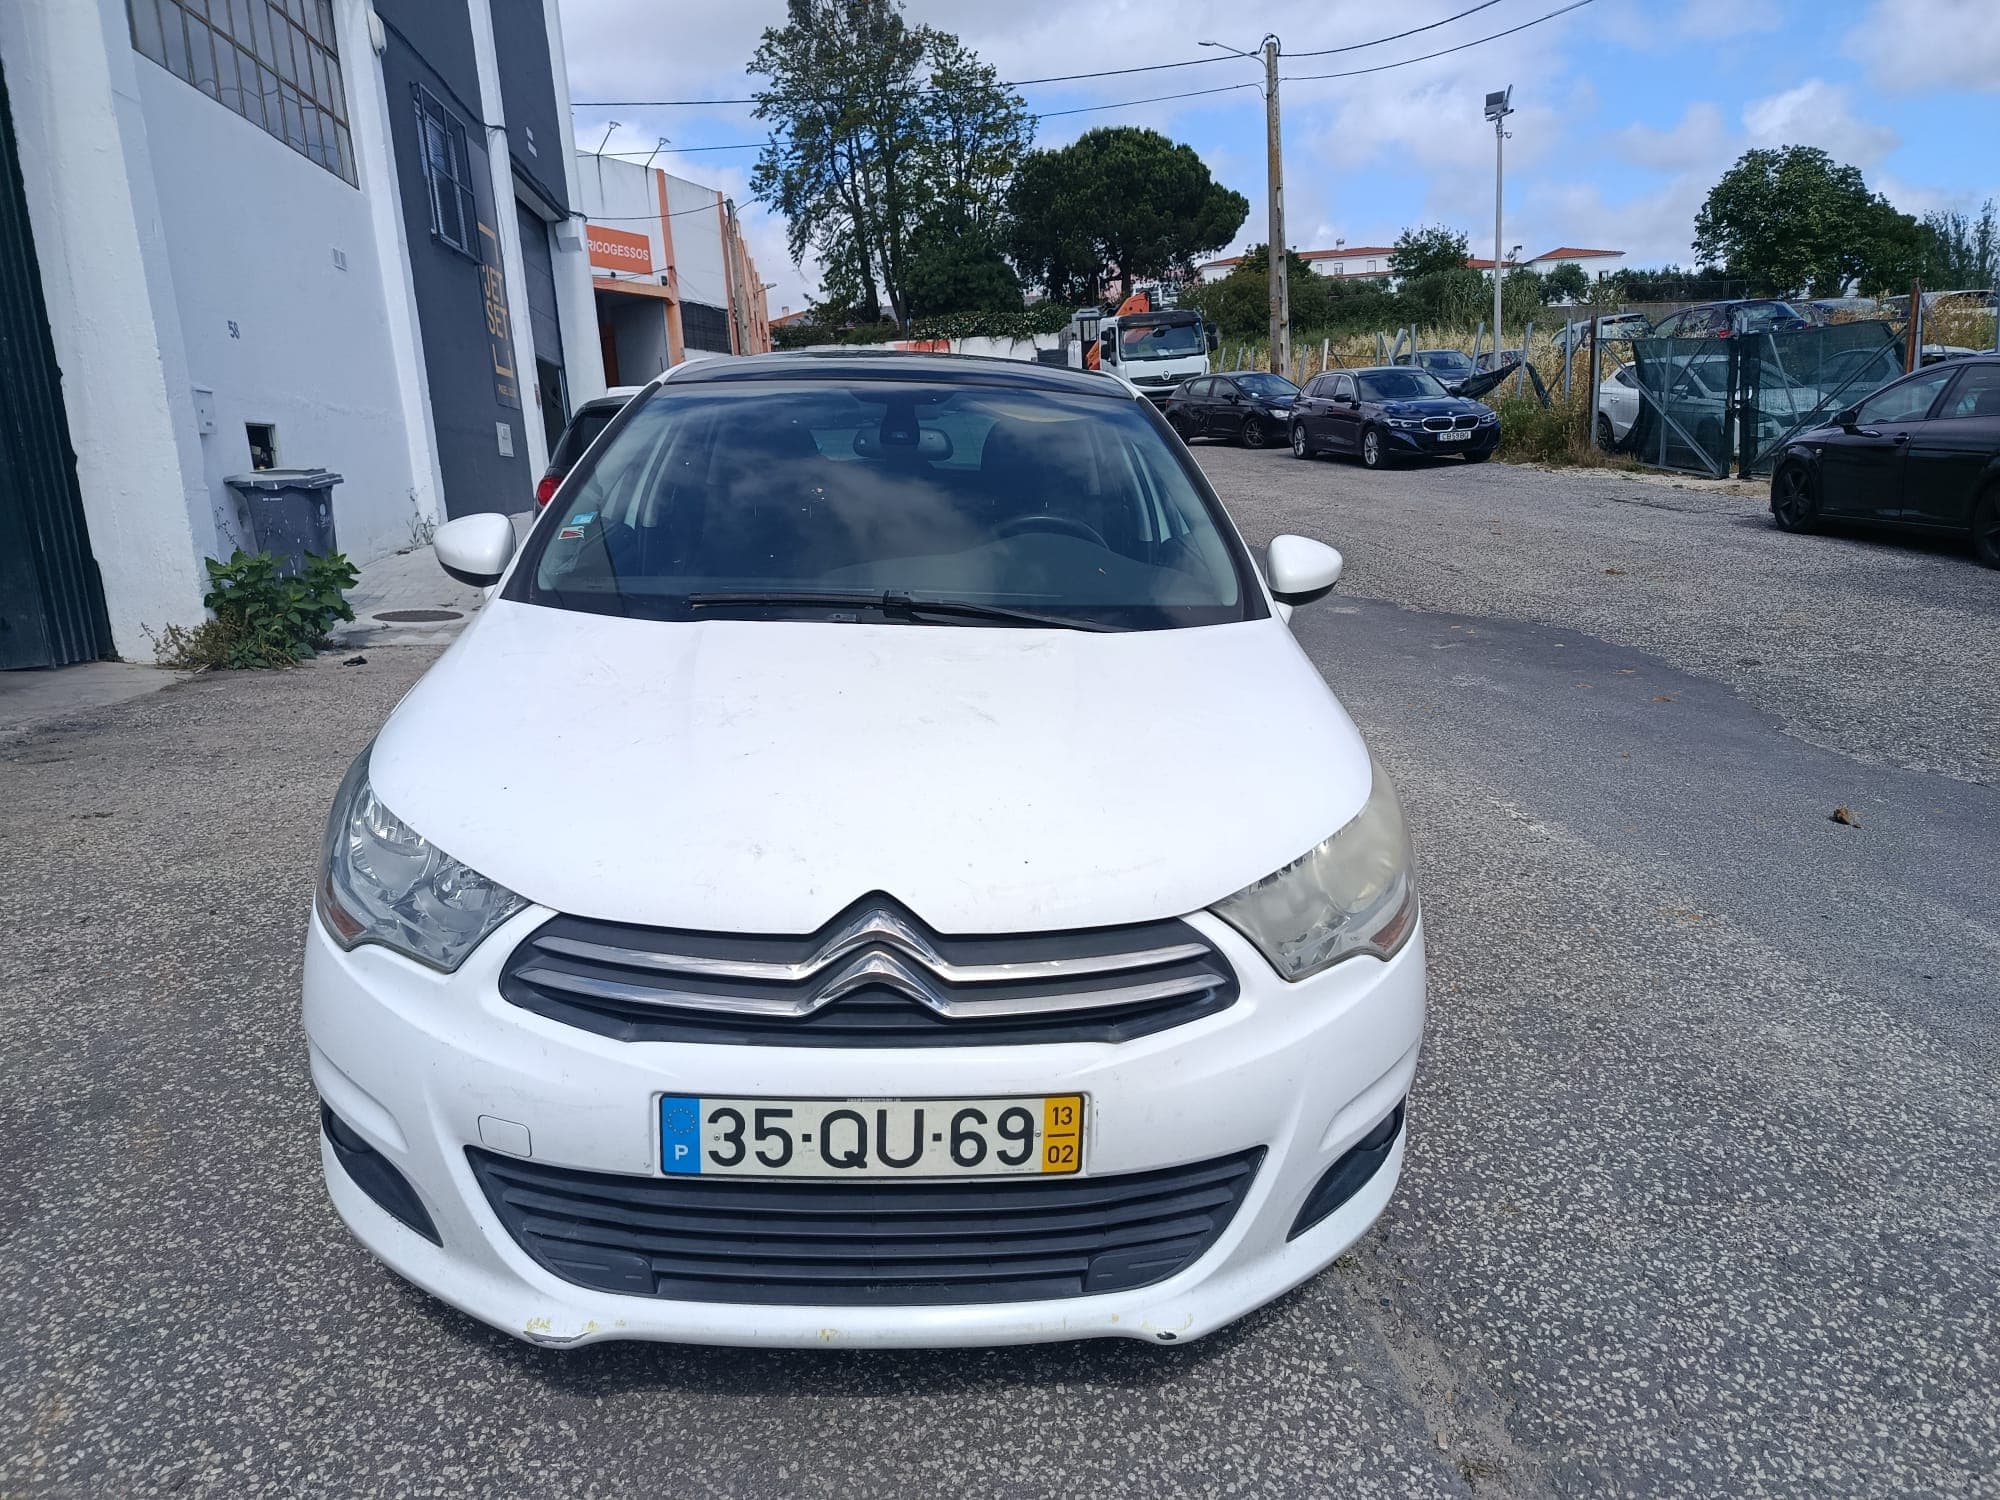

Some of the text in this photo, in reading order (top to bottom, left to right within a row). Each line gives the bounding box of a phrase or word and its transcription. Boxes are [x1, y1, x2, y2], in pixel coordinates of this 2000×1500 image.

[482, 263, 503, 306] JET
[227, 319, 240, 340] 58
[486, 301, 508, 341] SET
[1052, 1106, 1073, 1126] 13
[674, 1145, 688, 1160] P
[1047, 1145, 1074, 1165] 02
